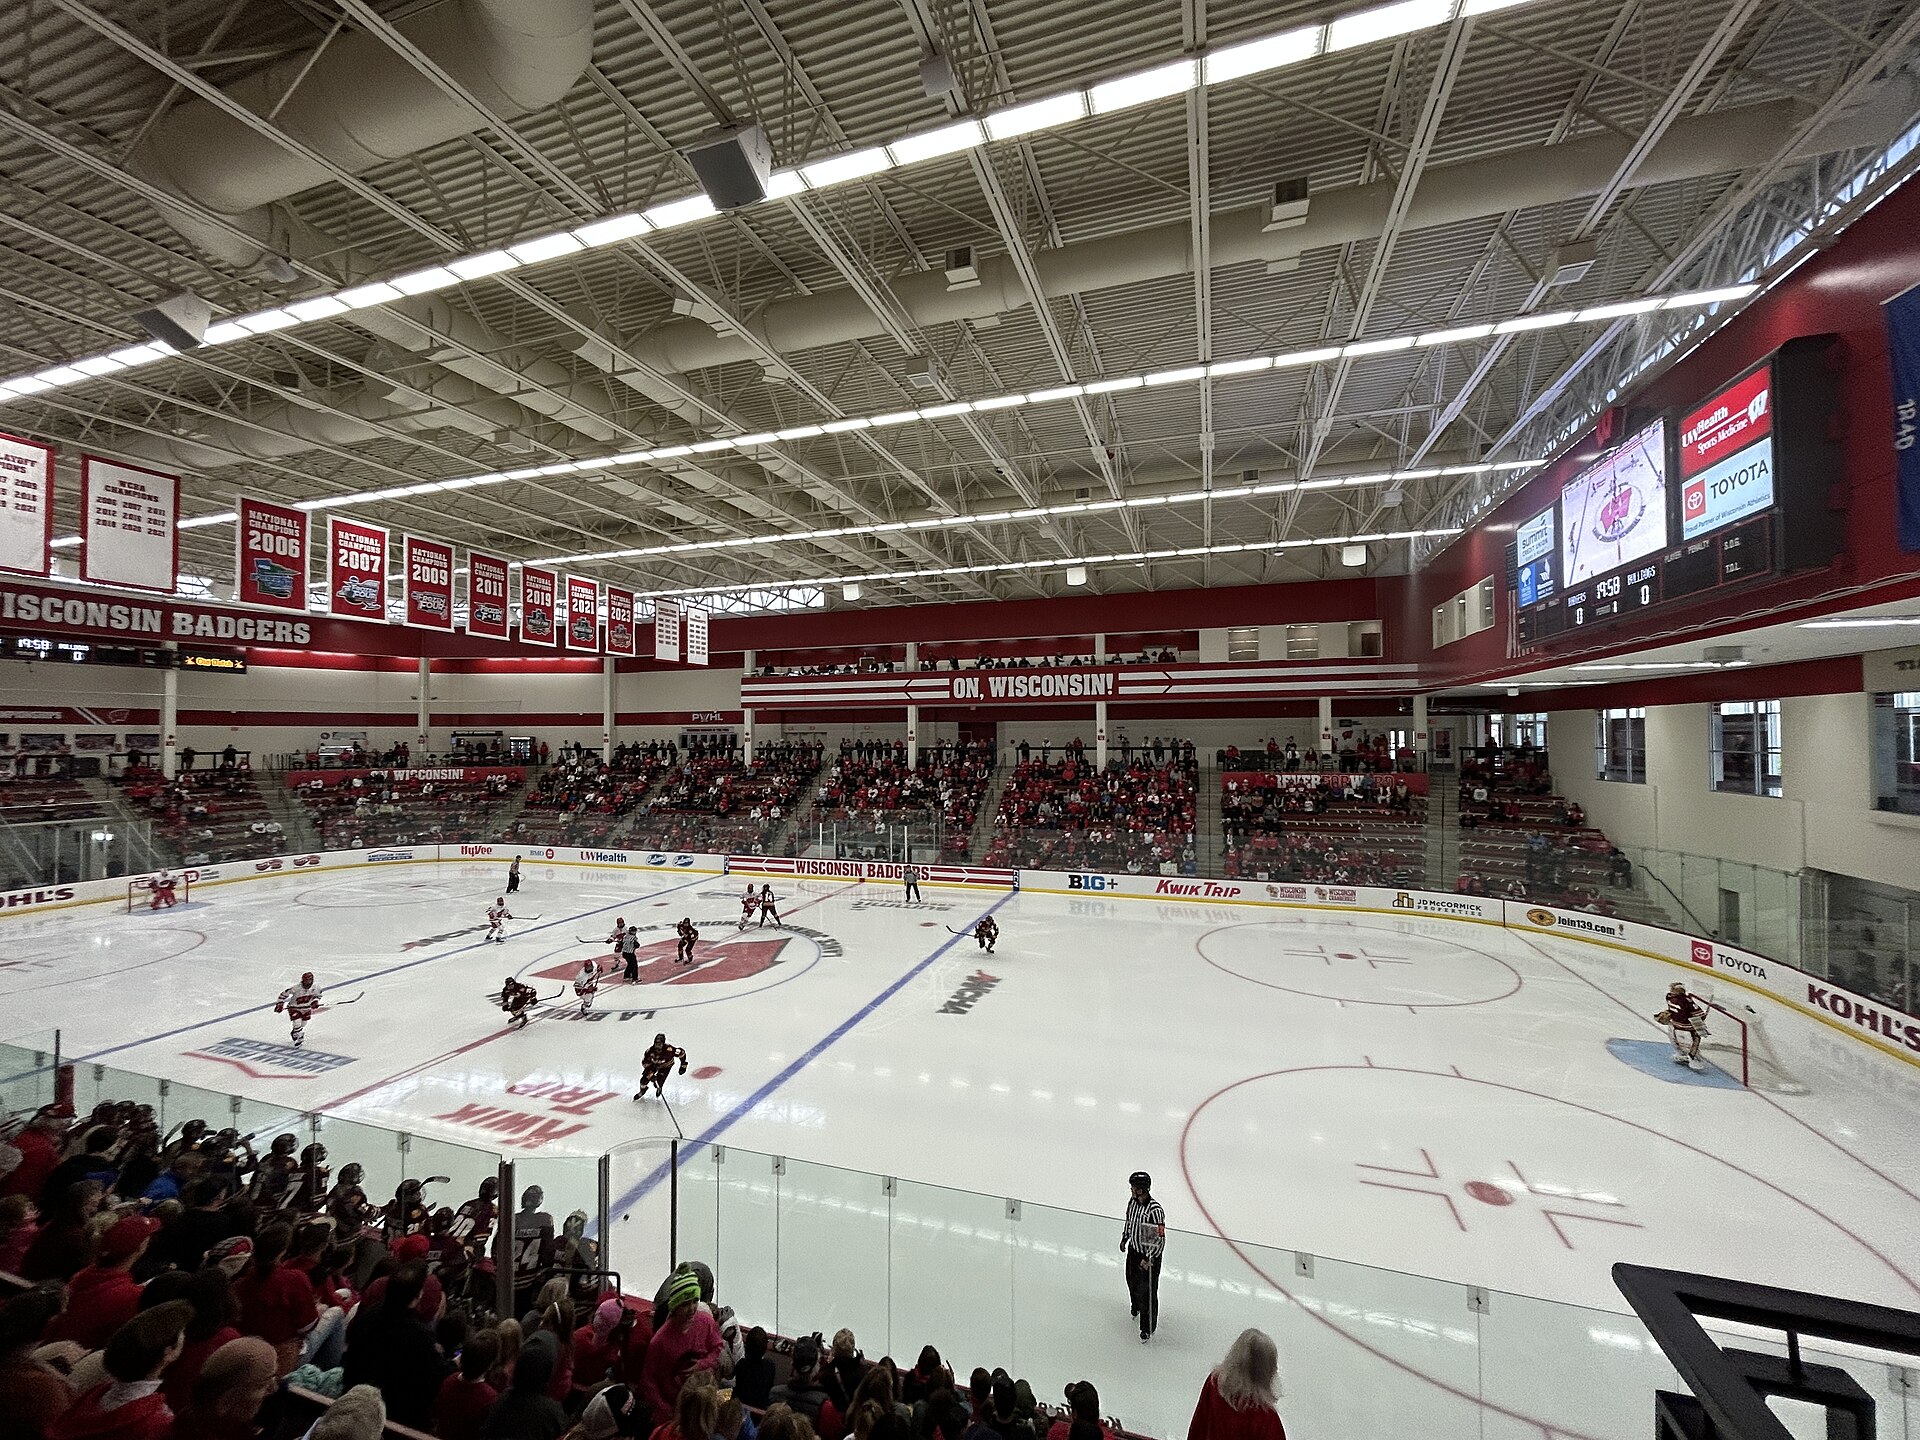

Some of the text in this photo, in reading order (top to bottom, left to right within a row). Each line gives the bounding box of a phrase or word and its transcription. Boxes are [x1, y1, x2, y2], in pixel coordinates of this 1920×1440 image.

[1697, 418, 1749, 454] Sports Medicine
[1710, 459, 1769, 499] TOYOTA
[104, 485, 159, 503] CHAMPIONS
[249, 509, 300, 529] NATIONAL
[249, 518, 300, 538] CHAMPIONS
[248, 530, 300, 558] 2006
[338, 531, 381, 547] NATIONAL
[338, 539, 381, 555] CHAMPIONS
[1522, 527, 1548, 550] summit
[338, 549, 381, 574] 2007
[412, 548, 447, 562] NATIONAL
[412, 555, 447, 569] CHAMPIONS
[412, 564, 448, 587] 2009
[474, 568, 504, 582] CHAMPIONS
[475, 562, 504, 575] NATIONAL
[1627, 566, 1656, 586] BULLDOGS
[475, 577, 503, 598] 2011
[526, 574, 551, 586] NATIONAL
[526, 581, 551, 591] CHAMPIONS
[1596, 576, 1620, 600] 19:58
[526, 588, 551, 607] 2019
[1641, 585, 1650, 605] 0
[419, 601, 445, 612] FOUR
[572, 598, 595, 615] 2021
[611, 607, 631, 623] 2023
[1613, 600, 1618, 613] 1
[0, 592, 310, 644] ISCONSIN BADGERS
[1576, 607, 1584, 625] 0
[18, 639, 51, 650] 19:58
[953, 673, 1114, 700] ON, WISCONSIN!
[795, 860, 863, 877] WISCONSIN
[1417, 906, 1482, 917] PROPERTIES
[1429, 900, 1482, 911] McCORMICK
[1557, 915, 1616, 936] Join139.com
[1717, 953, 1767, 980] TOYOTA
[1807, 982, 1920, 1051] KOHL'S
